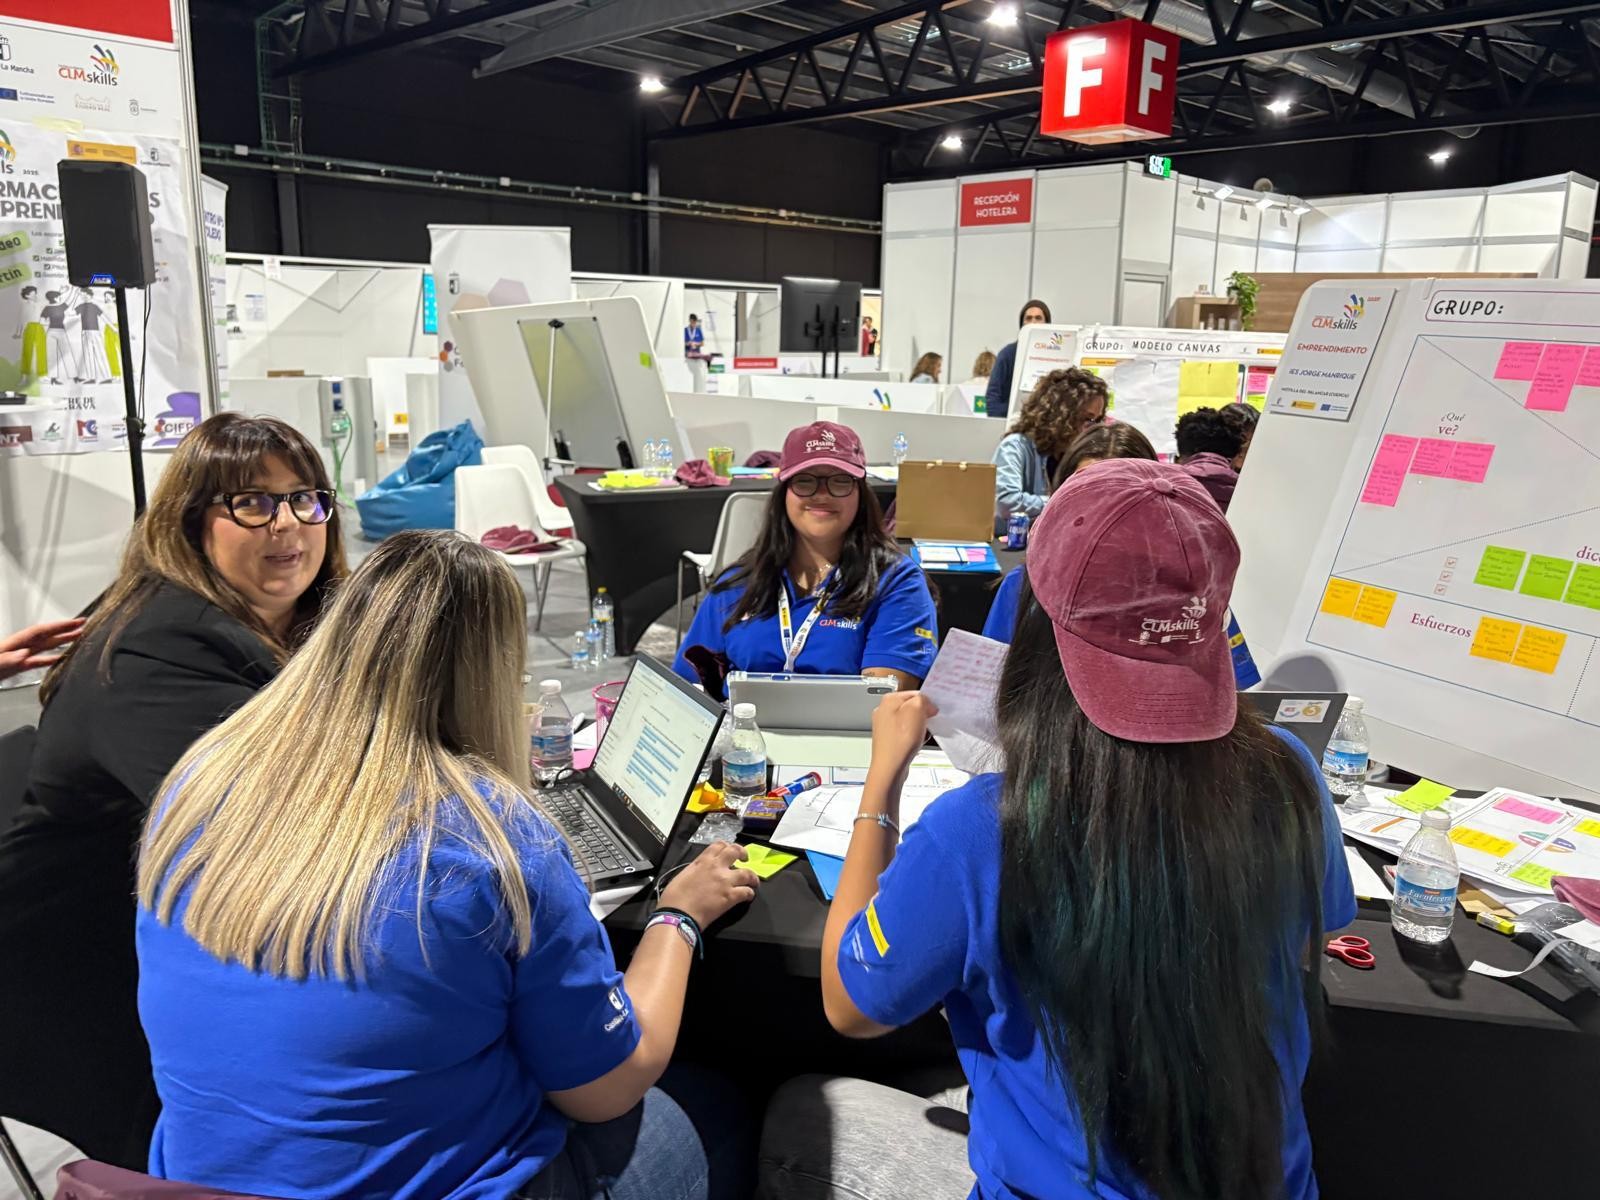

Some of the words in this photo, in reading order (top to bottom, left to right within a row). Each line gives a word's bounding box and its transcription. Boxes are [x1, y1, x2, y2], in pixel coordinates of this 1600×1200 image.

[58, 67, 118, 86] CLMskills
[1063, 36, 1107, 117] F
[1138, 39, 1167, 115] F
[974, 191, 1020, 205] RECEPCIÓN
[976, 207, 1018, 218] HOTELERA
[1434, 299, 1503, 315] GRUPO:
[1312, 317, 1358, 330] CLMskills
[1085, 341, 1123, 350] GRUPO:
[1132, 340, 1173, 351] MODELO
[1178, 342, 1221, 353] CANVAS
[1297, 343, 1368, 354] EMPRENDIMIENTO
[1299, 369, 1321, 377] JORGE
[1320, 371, 1357, 379] MANRIQUE
[1439, 424, 1459, 435] ve?
[820, 619, 857, 630] CLMskills
[1141, 619, 1199, 632] CLMskills
[1411, 612, 1472, 638] Esfuerzos
